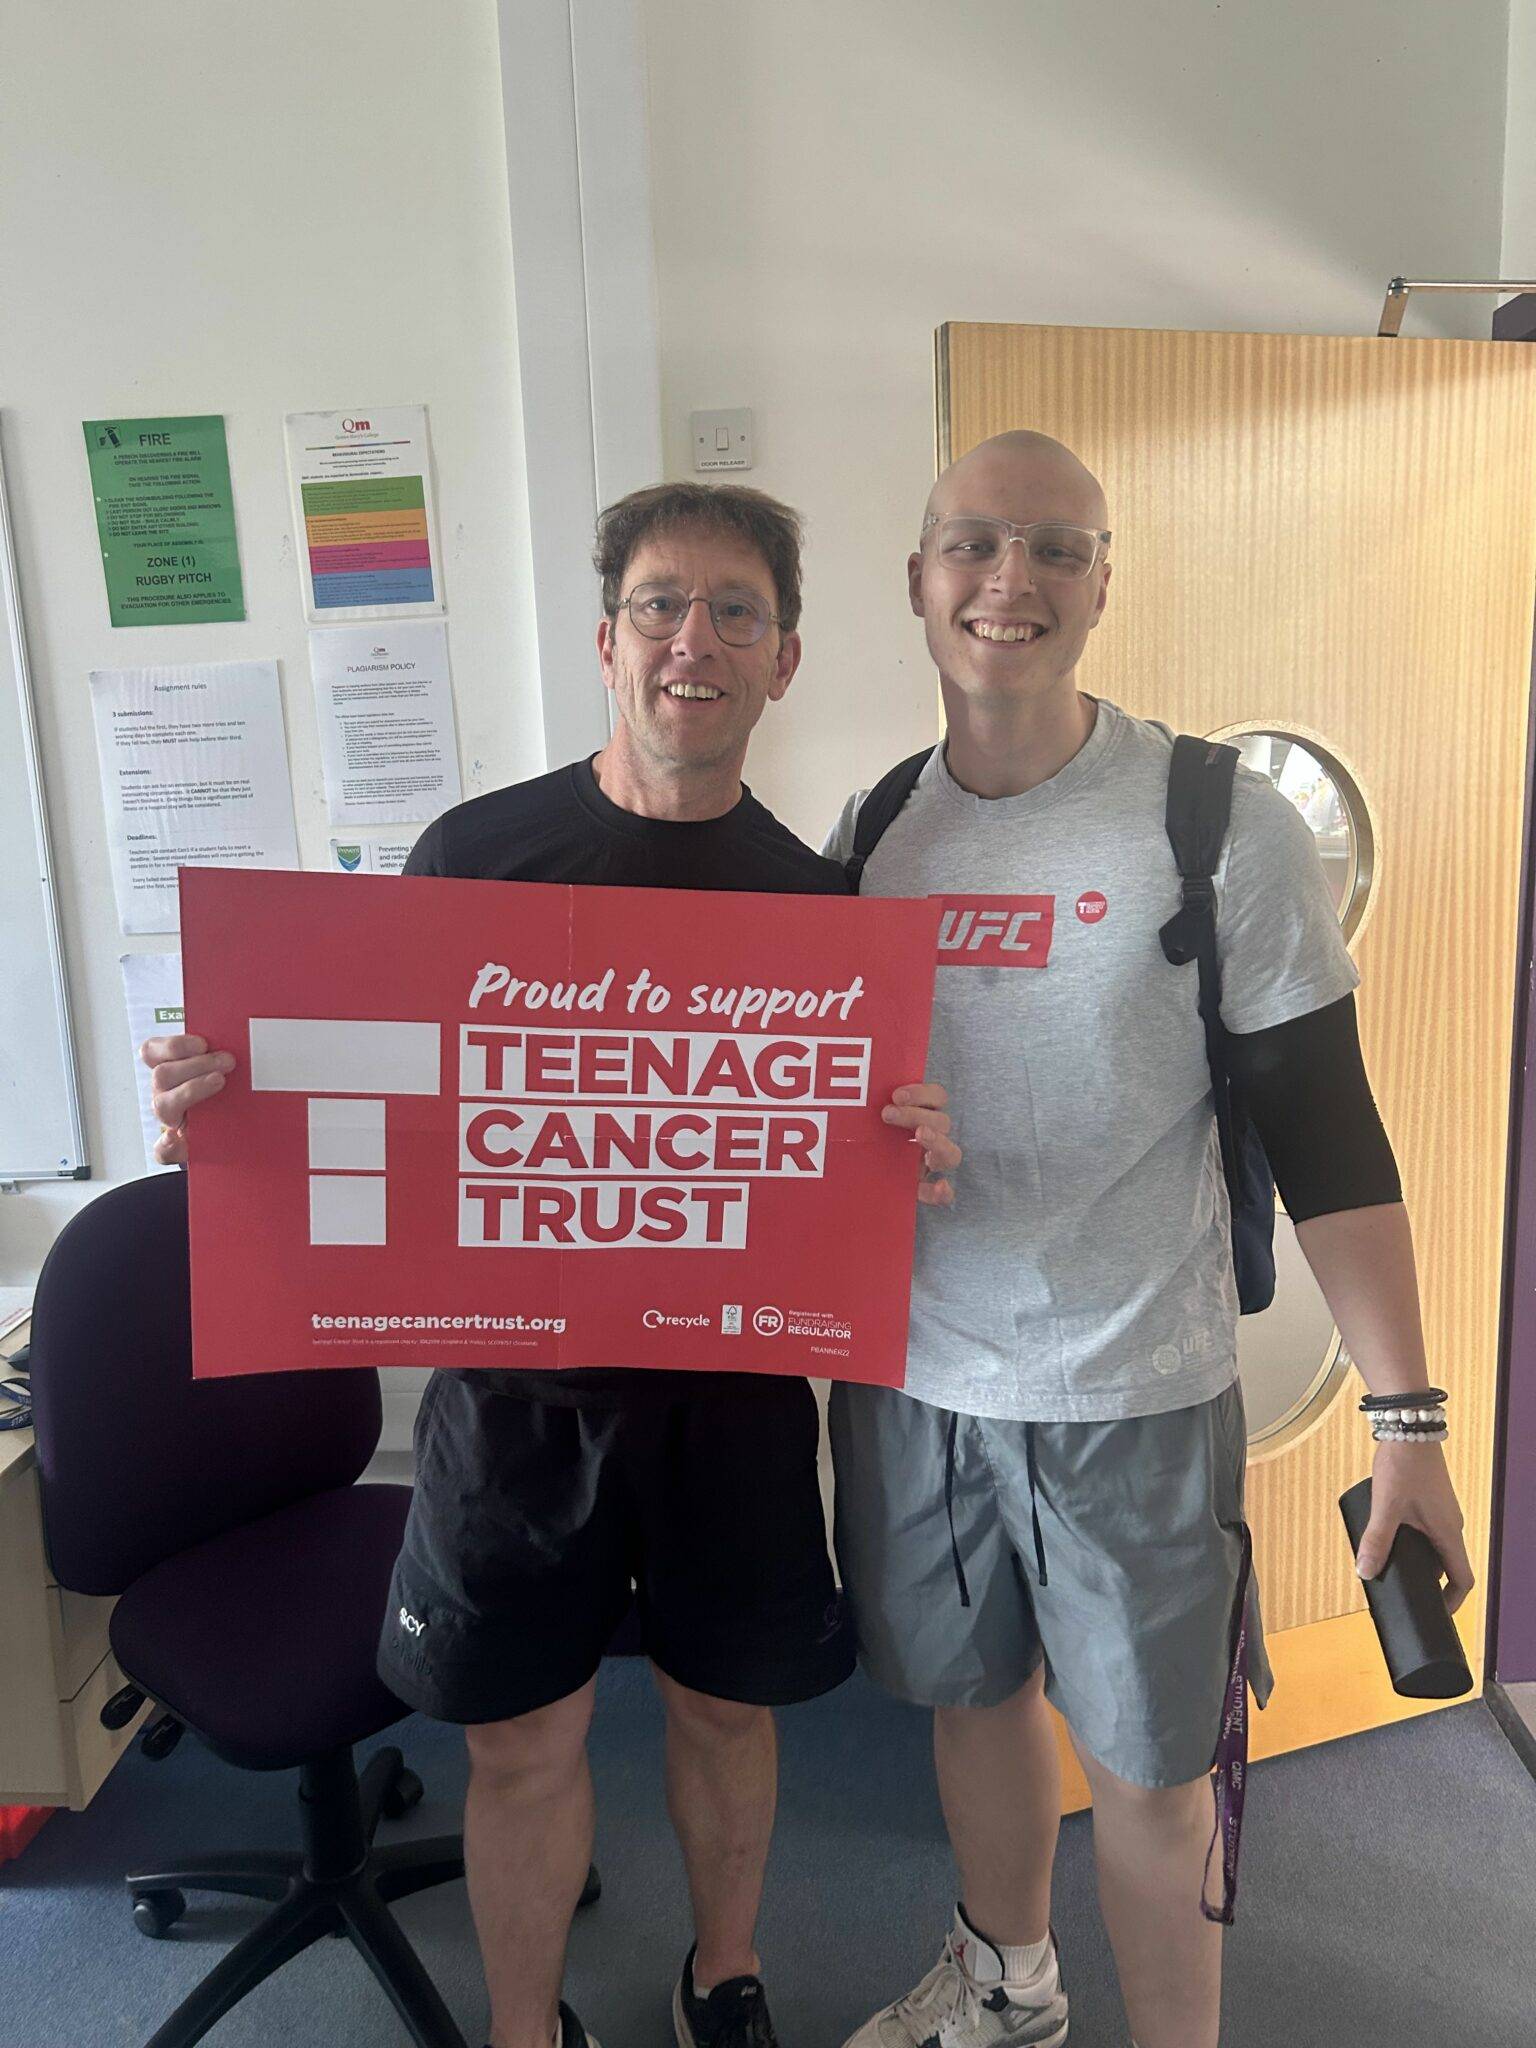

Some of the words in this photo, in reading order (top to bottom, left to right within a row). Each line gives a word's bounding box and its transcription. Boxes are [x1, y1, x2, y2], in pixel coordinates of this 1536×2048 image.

[139, 433, 172, 447] FIRE
[147, 556, 178, 568] ZONE
[181, 555, 196, 569] (1)
[136, 574, 175, 587] RUGBY
[178, 572, 212, 584] PITCH
[346, 664, 390, 673] PLAGIARISM
[390, 661, 416, 670] POLICY
[153, 683, 190, 692] Assignment
[937, 910, 1042, 951] UFC
[468, 962, 616, 1011] Proud
[626, 968, 672, 1014] to
[687, 976, 865, 1028] support
[466, 1030, 867, 1100] TEENAGE
[465, 1108, 820, 1172] CANCER
[465, 1184, 742, 1243] TRUST
[666, 1314, 711, 1329] recycle
[758, 1314, 779, 1328] FR
[788, 1310, 820, 1318] Registered
[311, 1313, 567, 1334] teenagecancertrust.org
[788, 1318, 852, 1331] FUNDRAISING
[788, 1326, 852, 1340] REGULATOR
[1231, 1675, 1244, 1734] STUDENT
[1231, 1761, 1242, 1790] QMC
